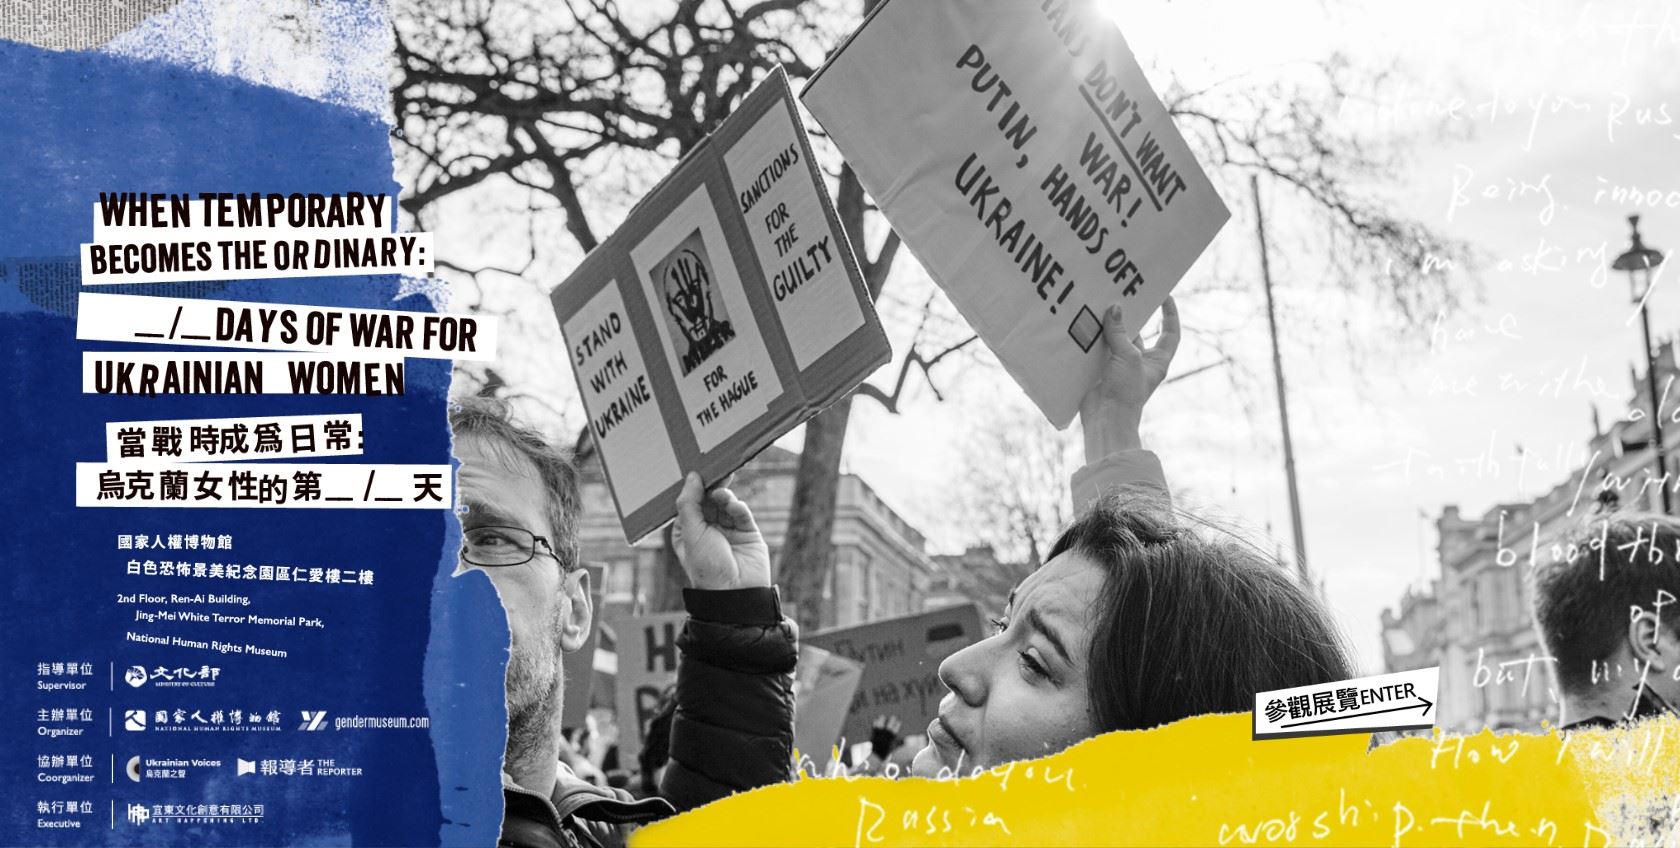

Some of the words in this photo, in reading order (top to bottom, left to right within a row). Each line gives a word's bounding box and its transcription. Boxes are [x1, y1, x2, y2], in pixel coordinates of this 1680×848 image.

[1085, 60, 1142, 139] DON'T
[1136, 131, 1187, 206] WANT
[740, 142, 800, 216] SANCTIONS
[955, 44, 1037, 169] PUTIN,
[1041, 163, 1109, 255] HANDS
[1105, 248, 1145, 297] OFF
[1079, 132, 1142, 229] WAR!
[764, 202, 790, 235] FOR
[774, 223, 799, 258] THE
[954, 152, 1076, 315] UKRAINE!
[772, 236, 834, 302] GUILTY
[575, 311, 622, 367] STAND
[591, 355, 628, 394] WITH
[696, 402, 719, 428] THE
[720, 370, 758, 418] HAGUE
[703, 365, 728, 393] FOR
[596, 375, 651, 440] UKRAINE
